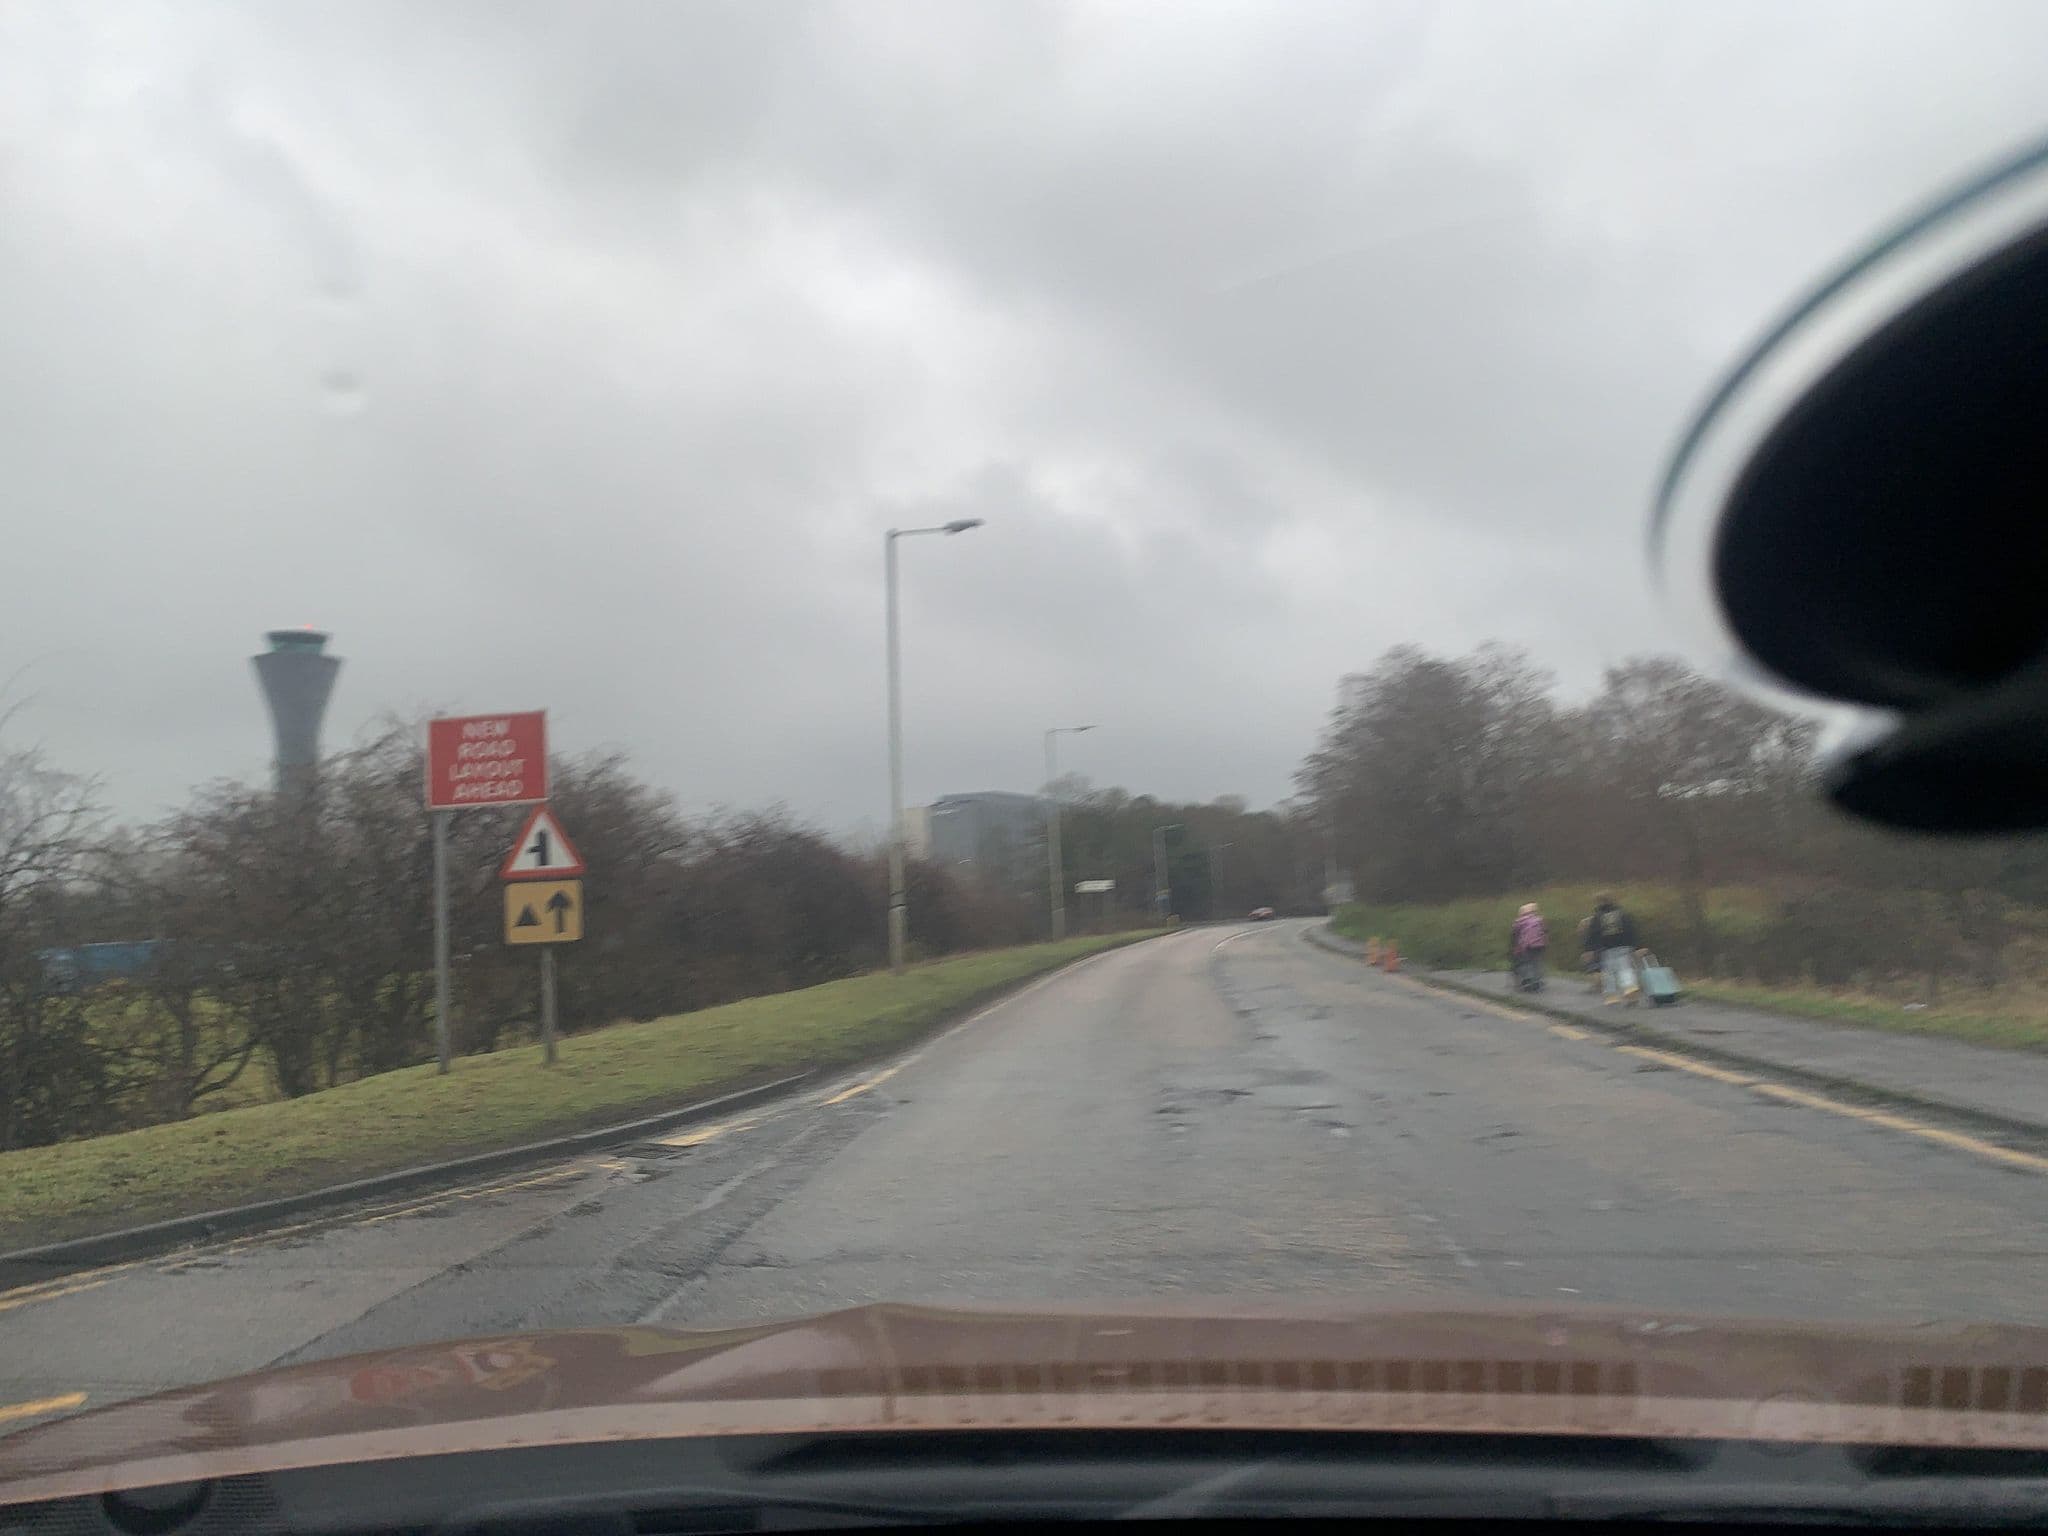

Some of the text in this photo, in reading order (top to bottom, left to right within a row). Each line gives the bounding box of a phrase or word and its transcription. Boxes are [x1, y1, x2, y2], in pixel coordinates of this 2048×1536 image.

[462, 720, 509, 738] NEW
[458, 740, 516, 758] ROAD
[449, 759, 525, 781] LAYOUT
[453, 779, 523, 800] AHEAD
